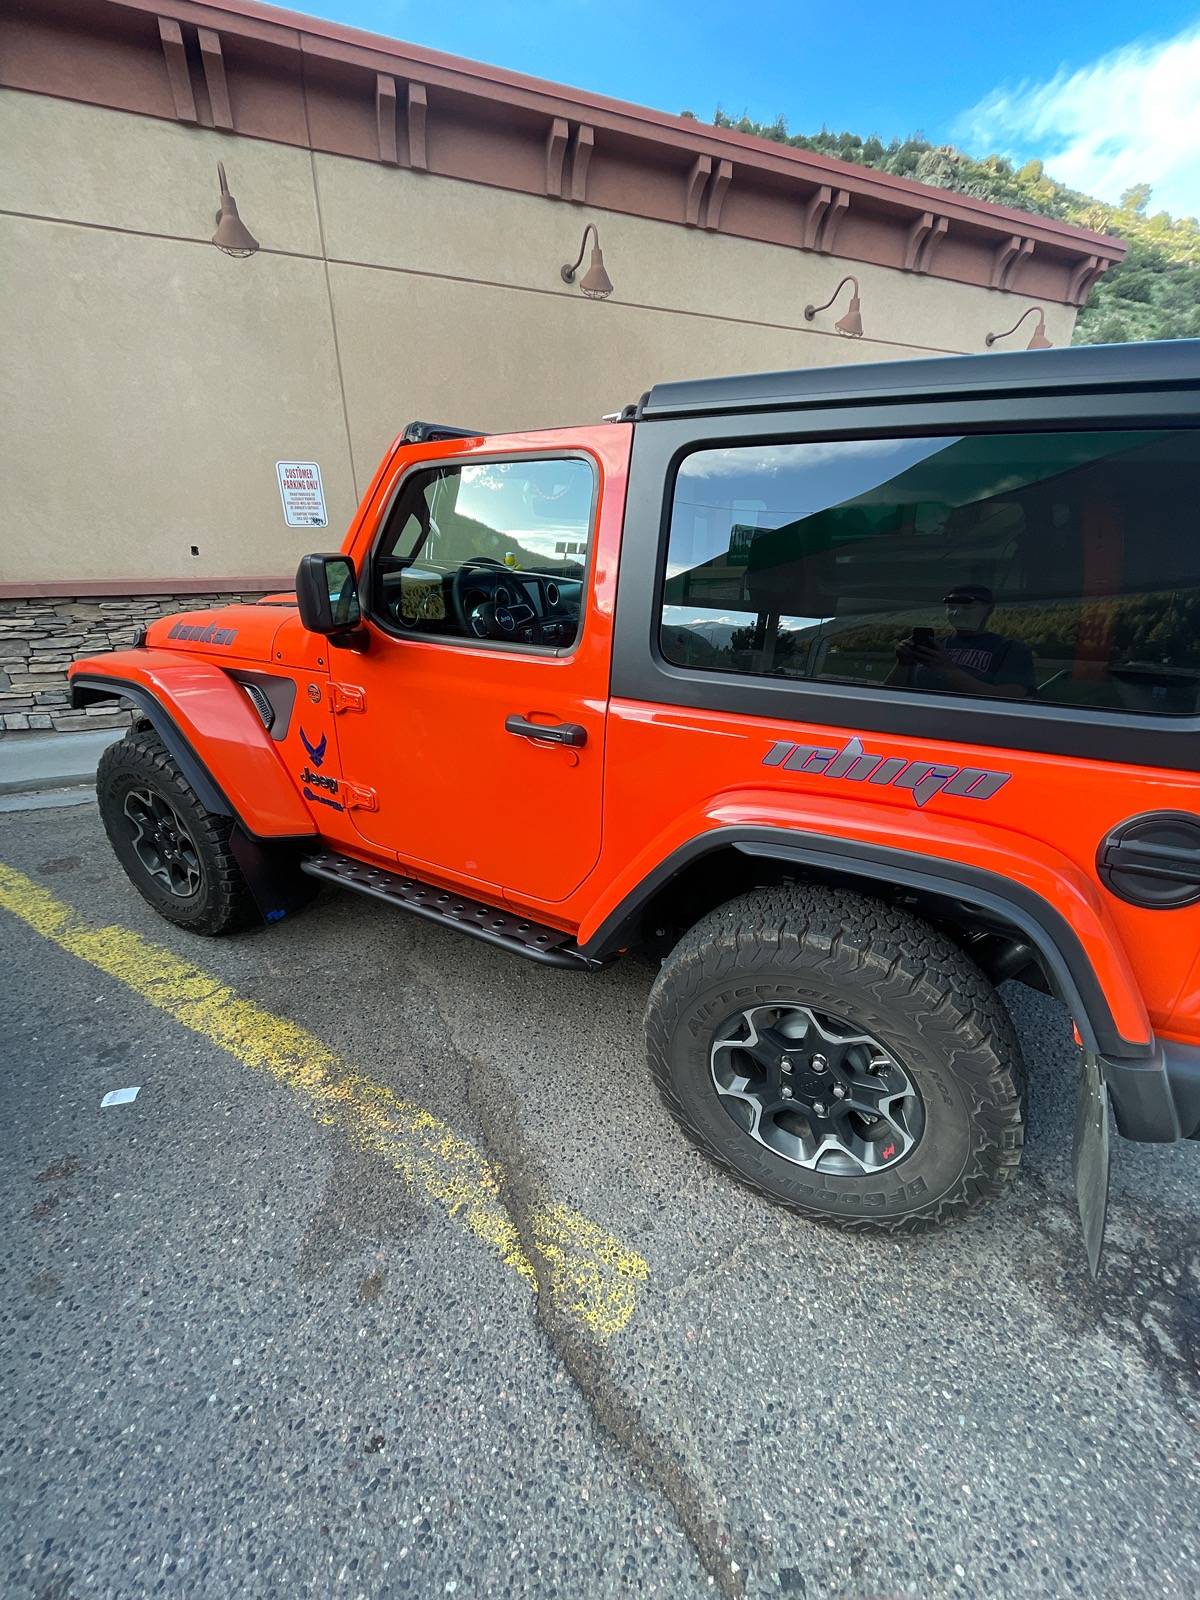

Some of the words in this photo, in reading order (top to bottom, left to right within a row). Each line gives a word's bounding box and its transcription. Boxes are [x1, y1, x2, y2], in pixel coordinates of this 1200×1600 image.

[285, 468, 313, 479] CUSTOMER
[283, 480, 305, 490] PARKING
[306, 480, 318, 490] ONLY
[300, 767, 338, 794] Jeep
